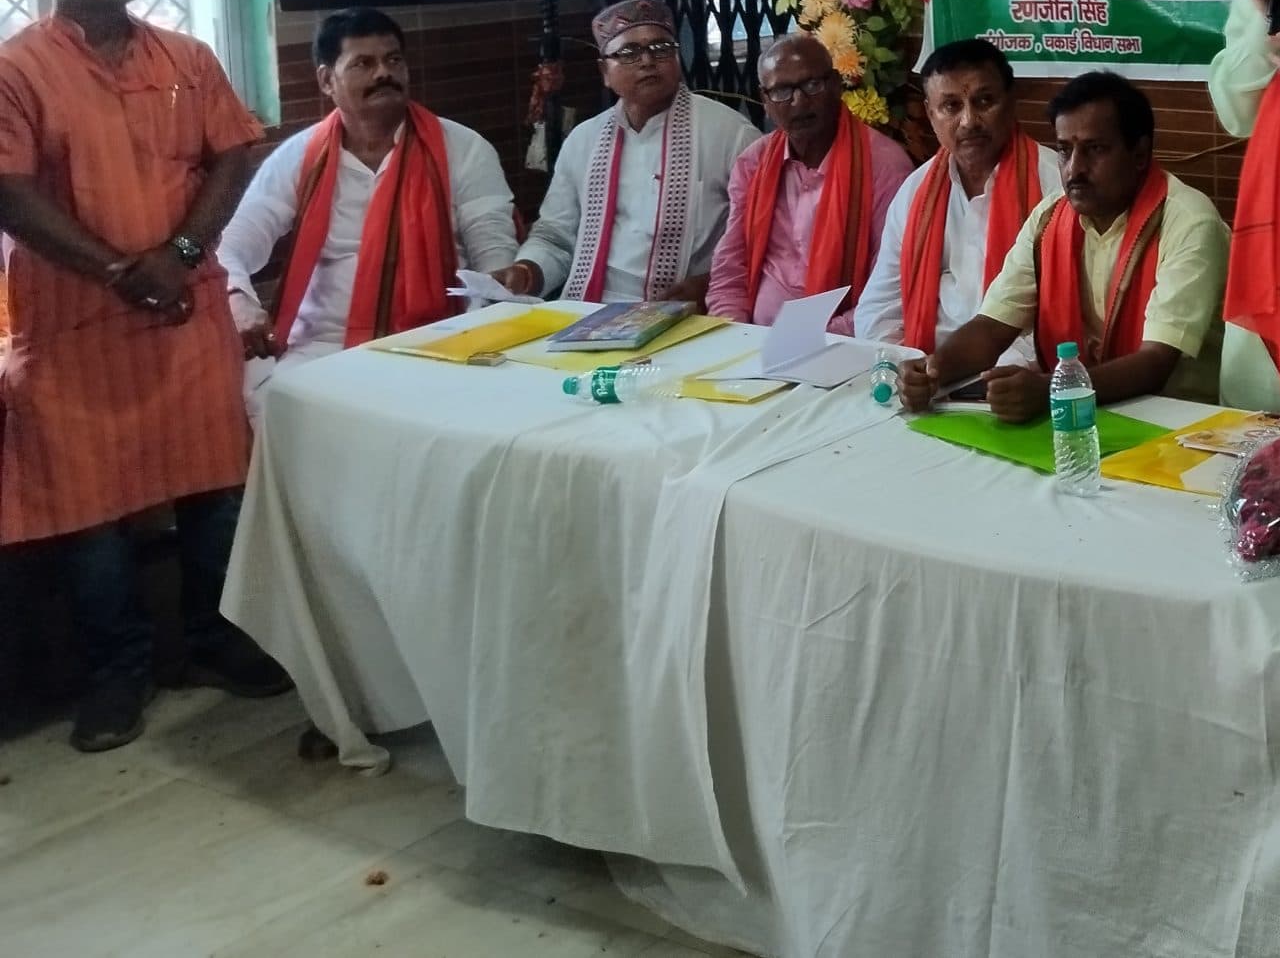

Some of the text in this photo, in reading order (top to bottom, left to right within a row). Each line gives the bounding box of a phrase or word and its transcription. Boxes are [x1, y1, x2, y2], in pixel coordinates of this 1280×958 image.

[979, 31, 1032, 50] ंयोजक
[1082, 33, 1114, 51] विधान
[1116, 37, 1140, 52] सभा
